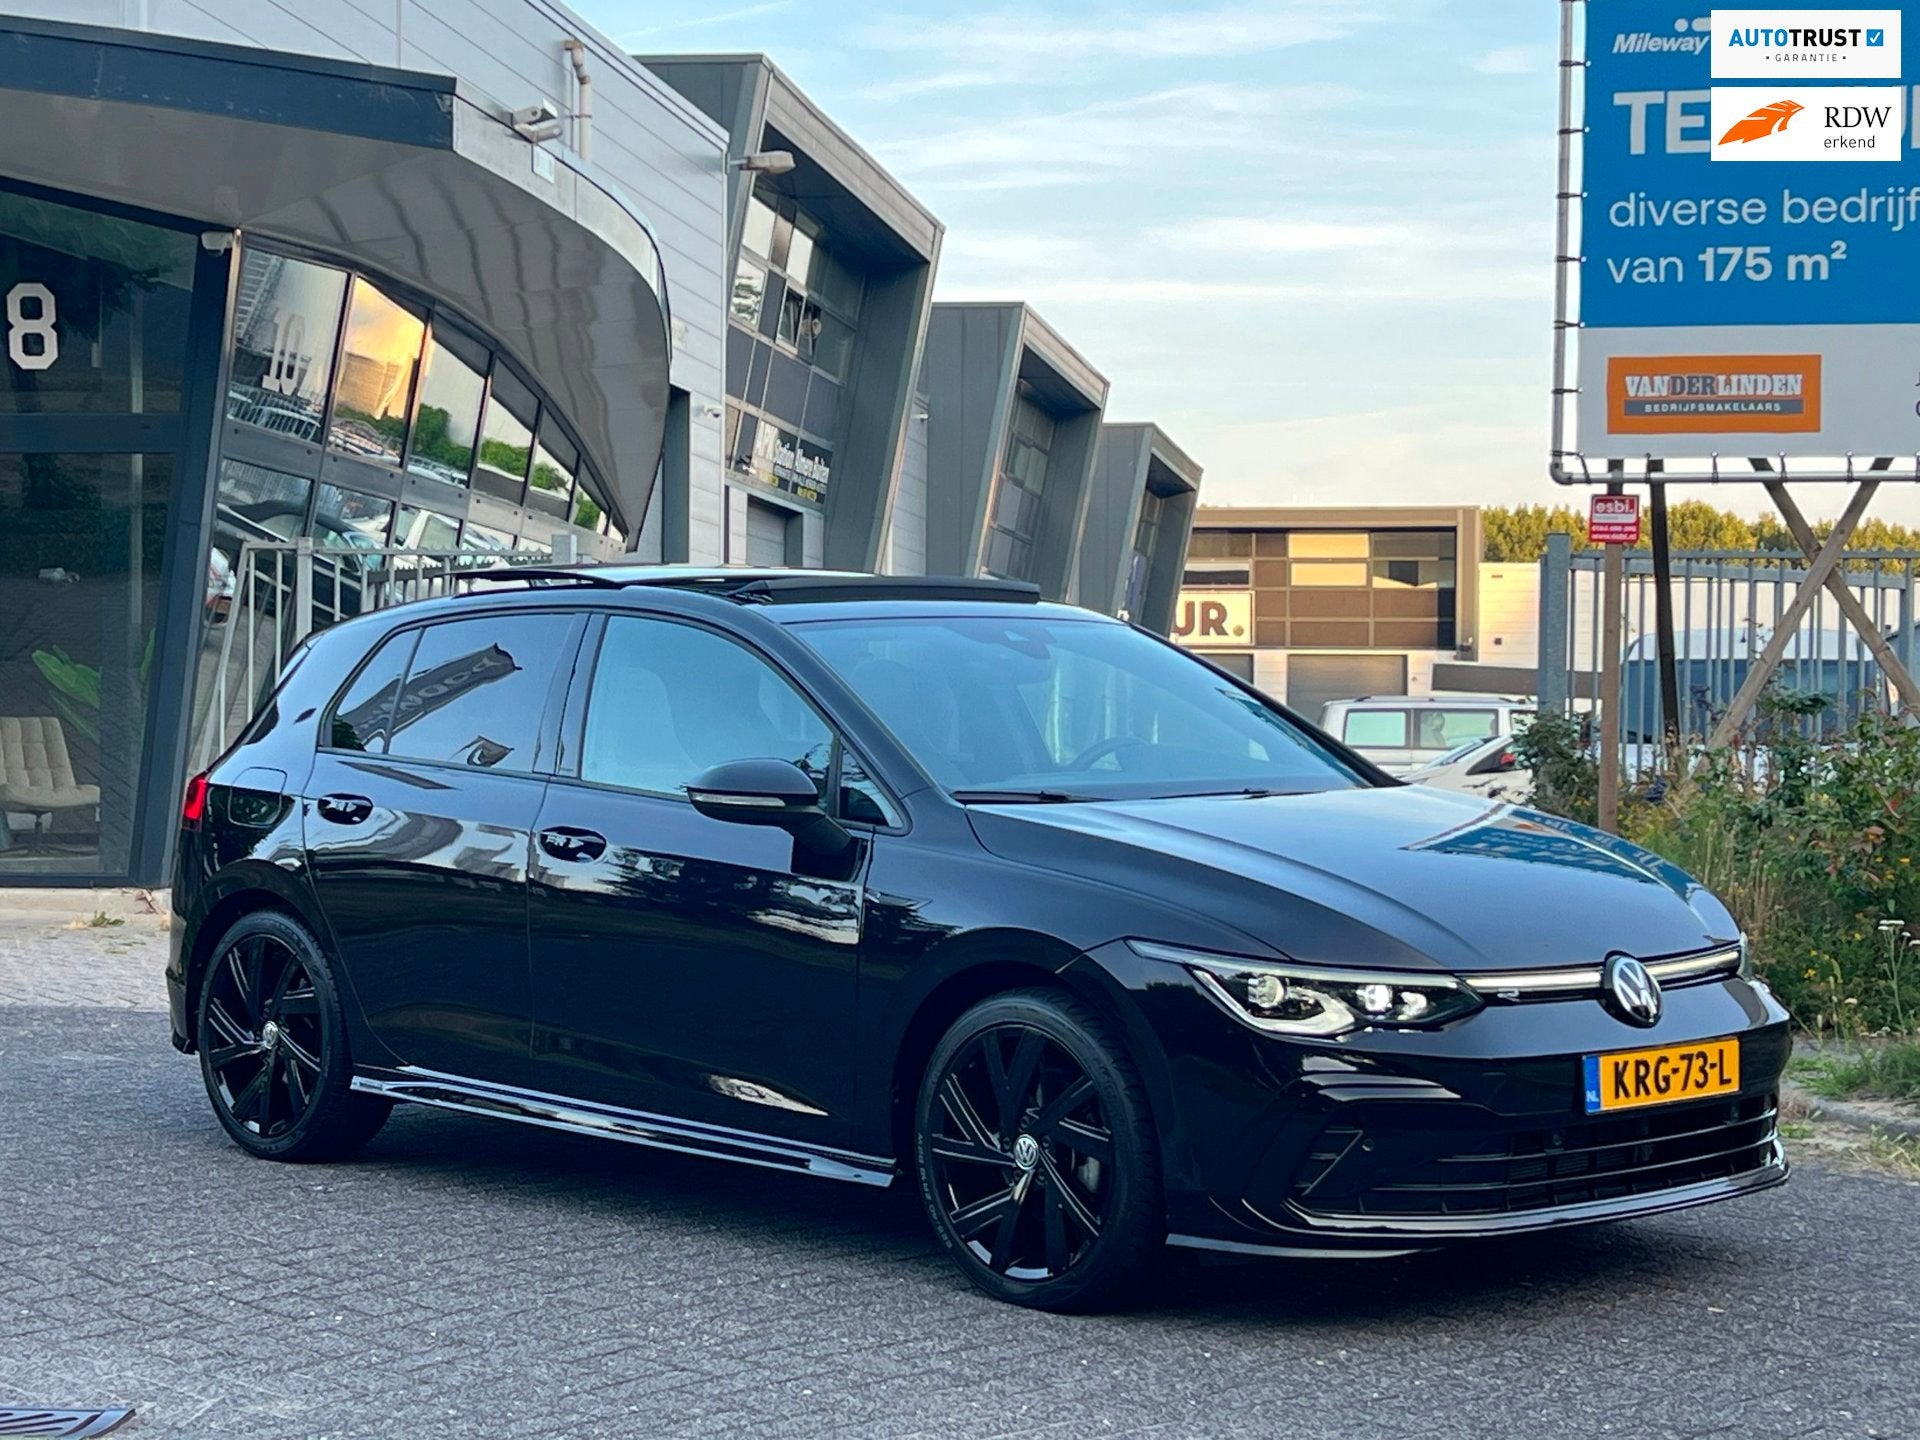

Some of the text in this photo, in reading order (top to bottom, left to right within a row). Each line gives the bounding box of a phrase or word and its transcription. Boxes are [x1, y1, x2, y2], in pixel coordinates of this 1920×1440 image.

[1612, 33, 1710, 55] Mileway
[1609, 192, 1767, 227] diverse
[1607, 240, 1847, 284] van 175 m²
[7, 283, 58, 370] 8
[262, 308, 306, 396] 10
[1644, 403, 1781, 413] BEDRIJFSMAKELAARS
[1614, 1049, 1732, 1099] KRG-73-L
[1586, 1090, 1599, 1102] NL
